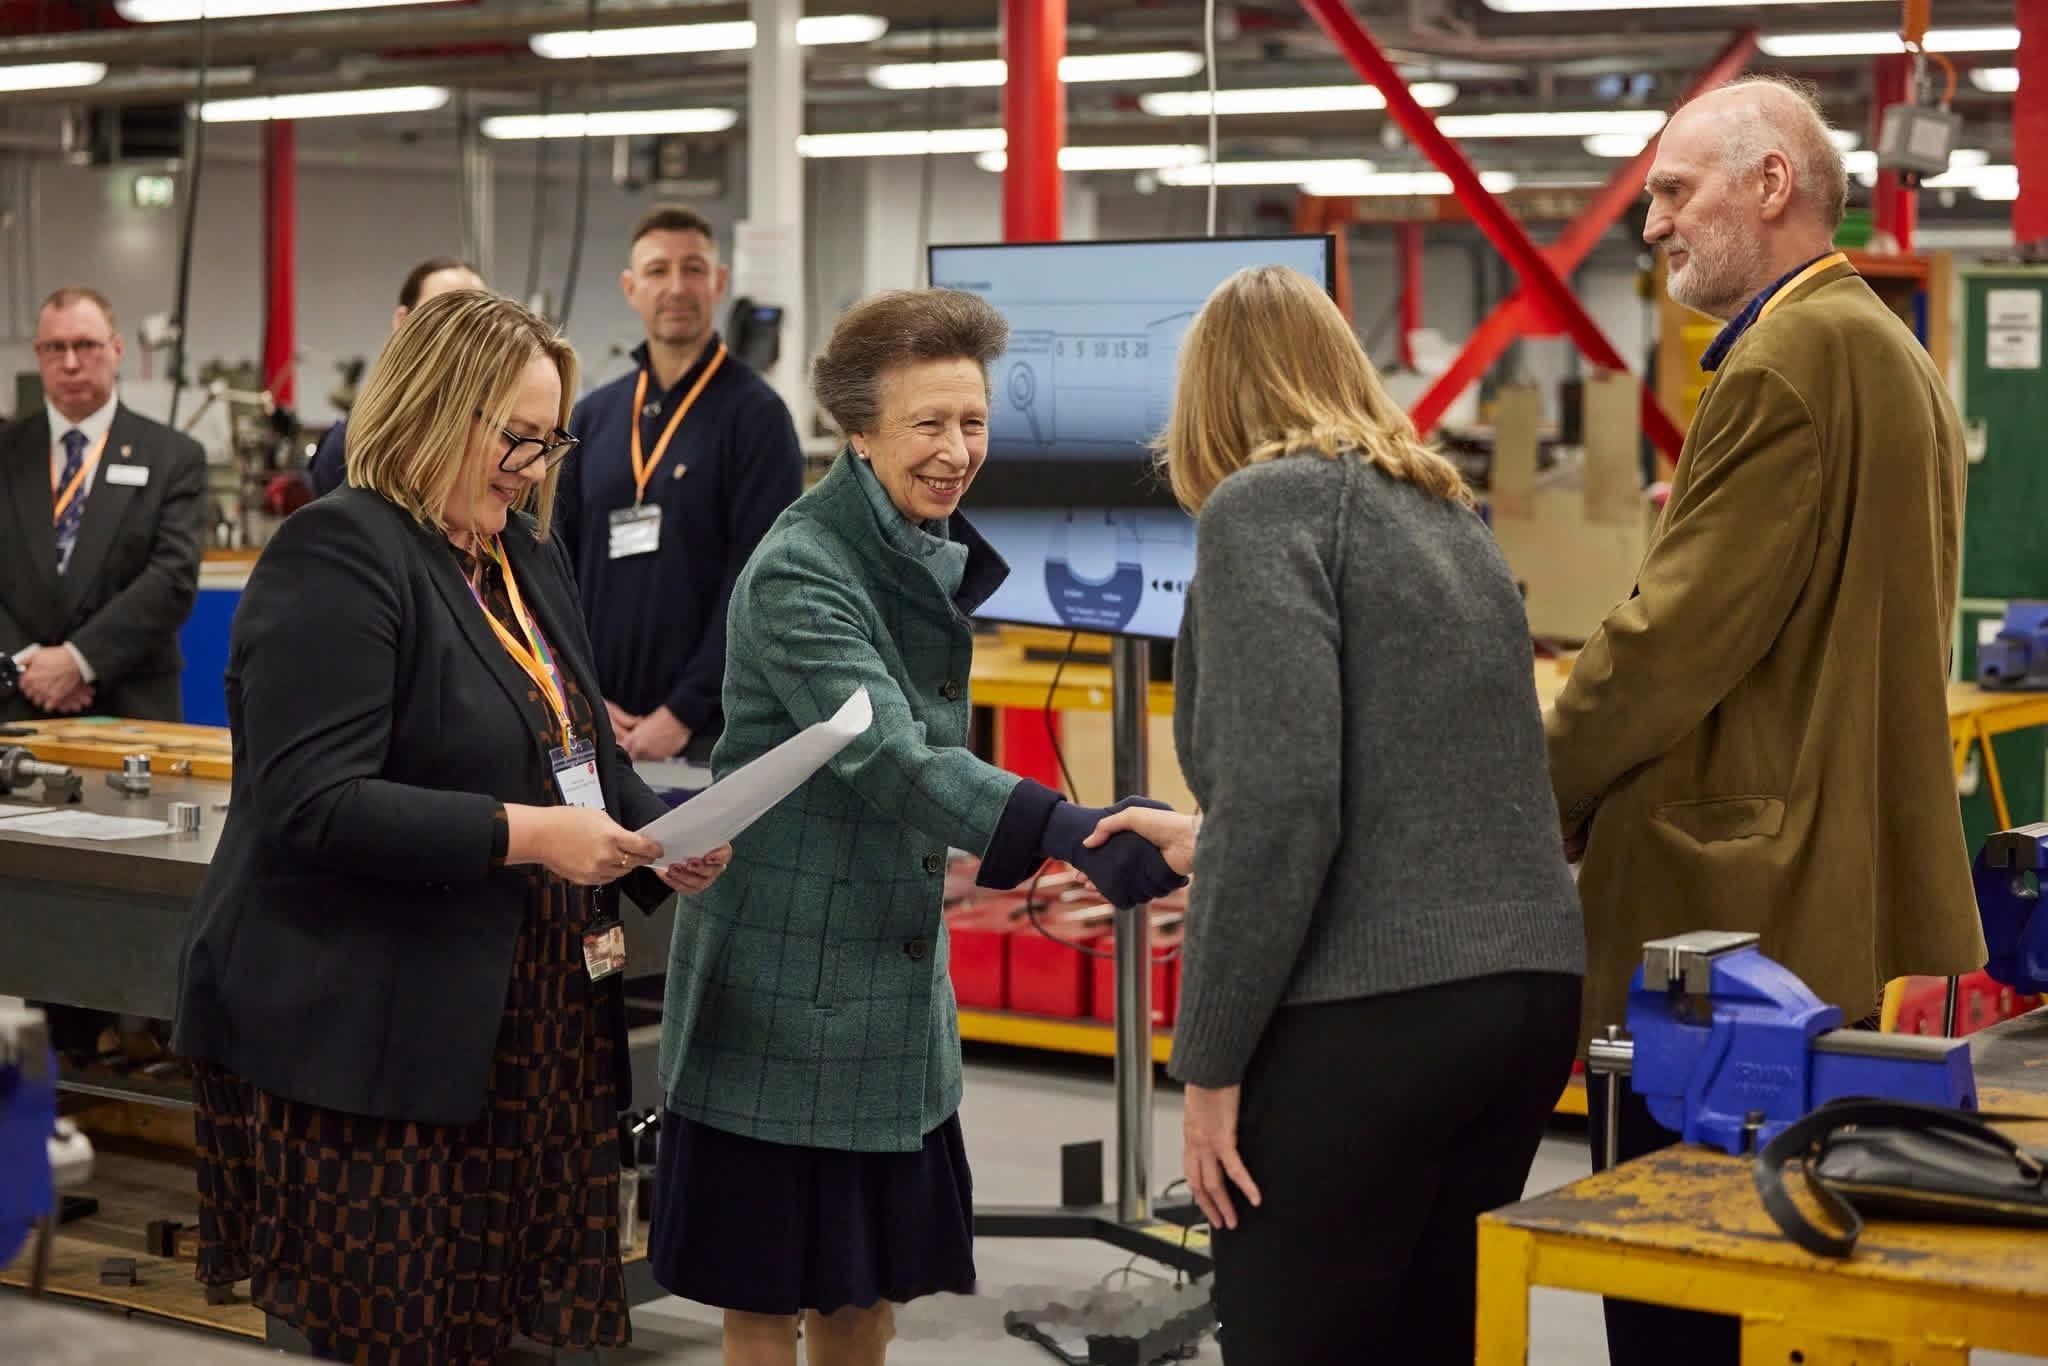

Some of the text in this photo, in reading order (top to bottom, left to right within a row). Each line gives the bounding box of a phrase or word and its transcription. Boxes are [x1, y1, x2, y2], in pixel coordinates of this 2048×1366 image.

[1076, 340, 1085, 358] 5
[1094, 341, 1109, 358] 10
[1115, 341, 1128, 358] 15
[1135, 342, 1149, 358] 20
